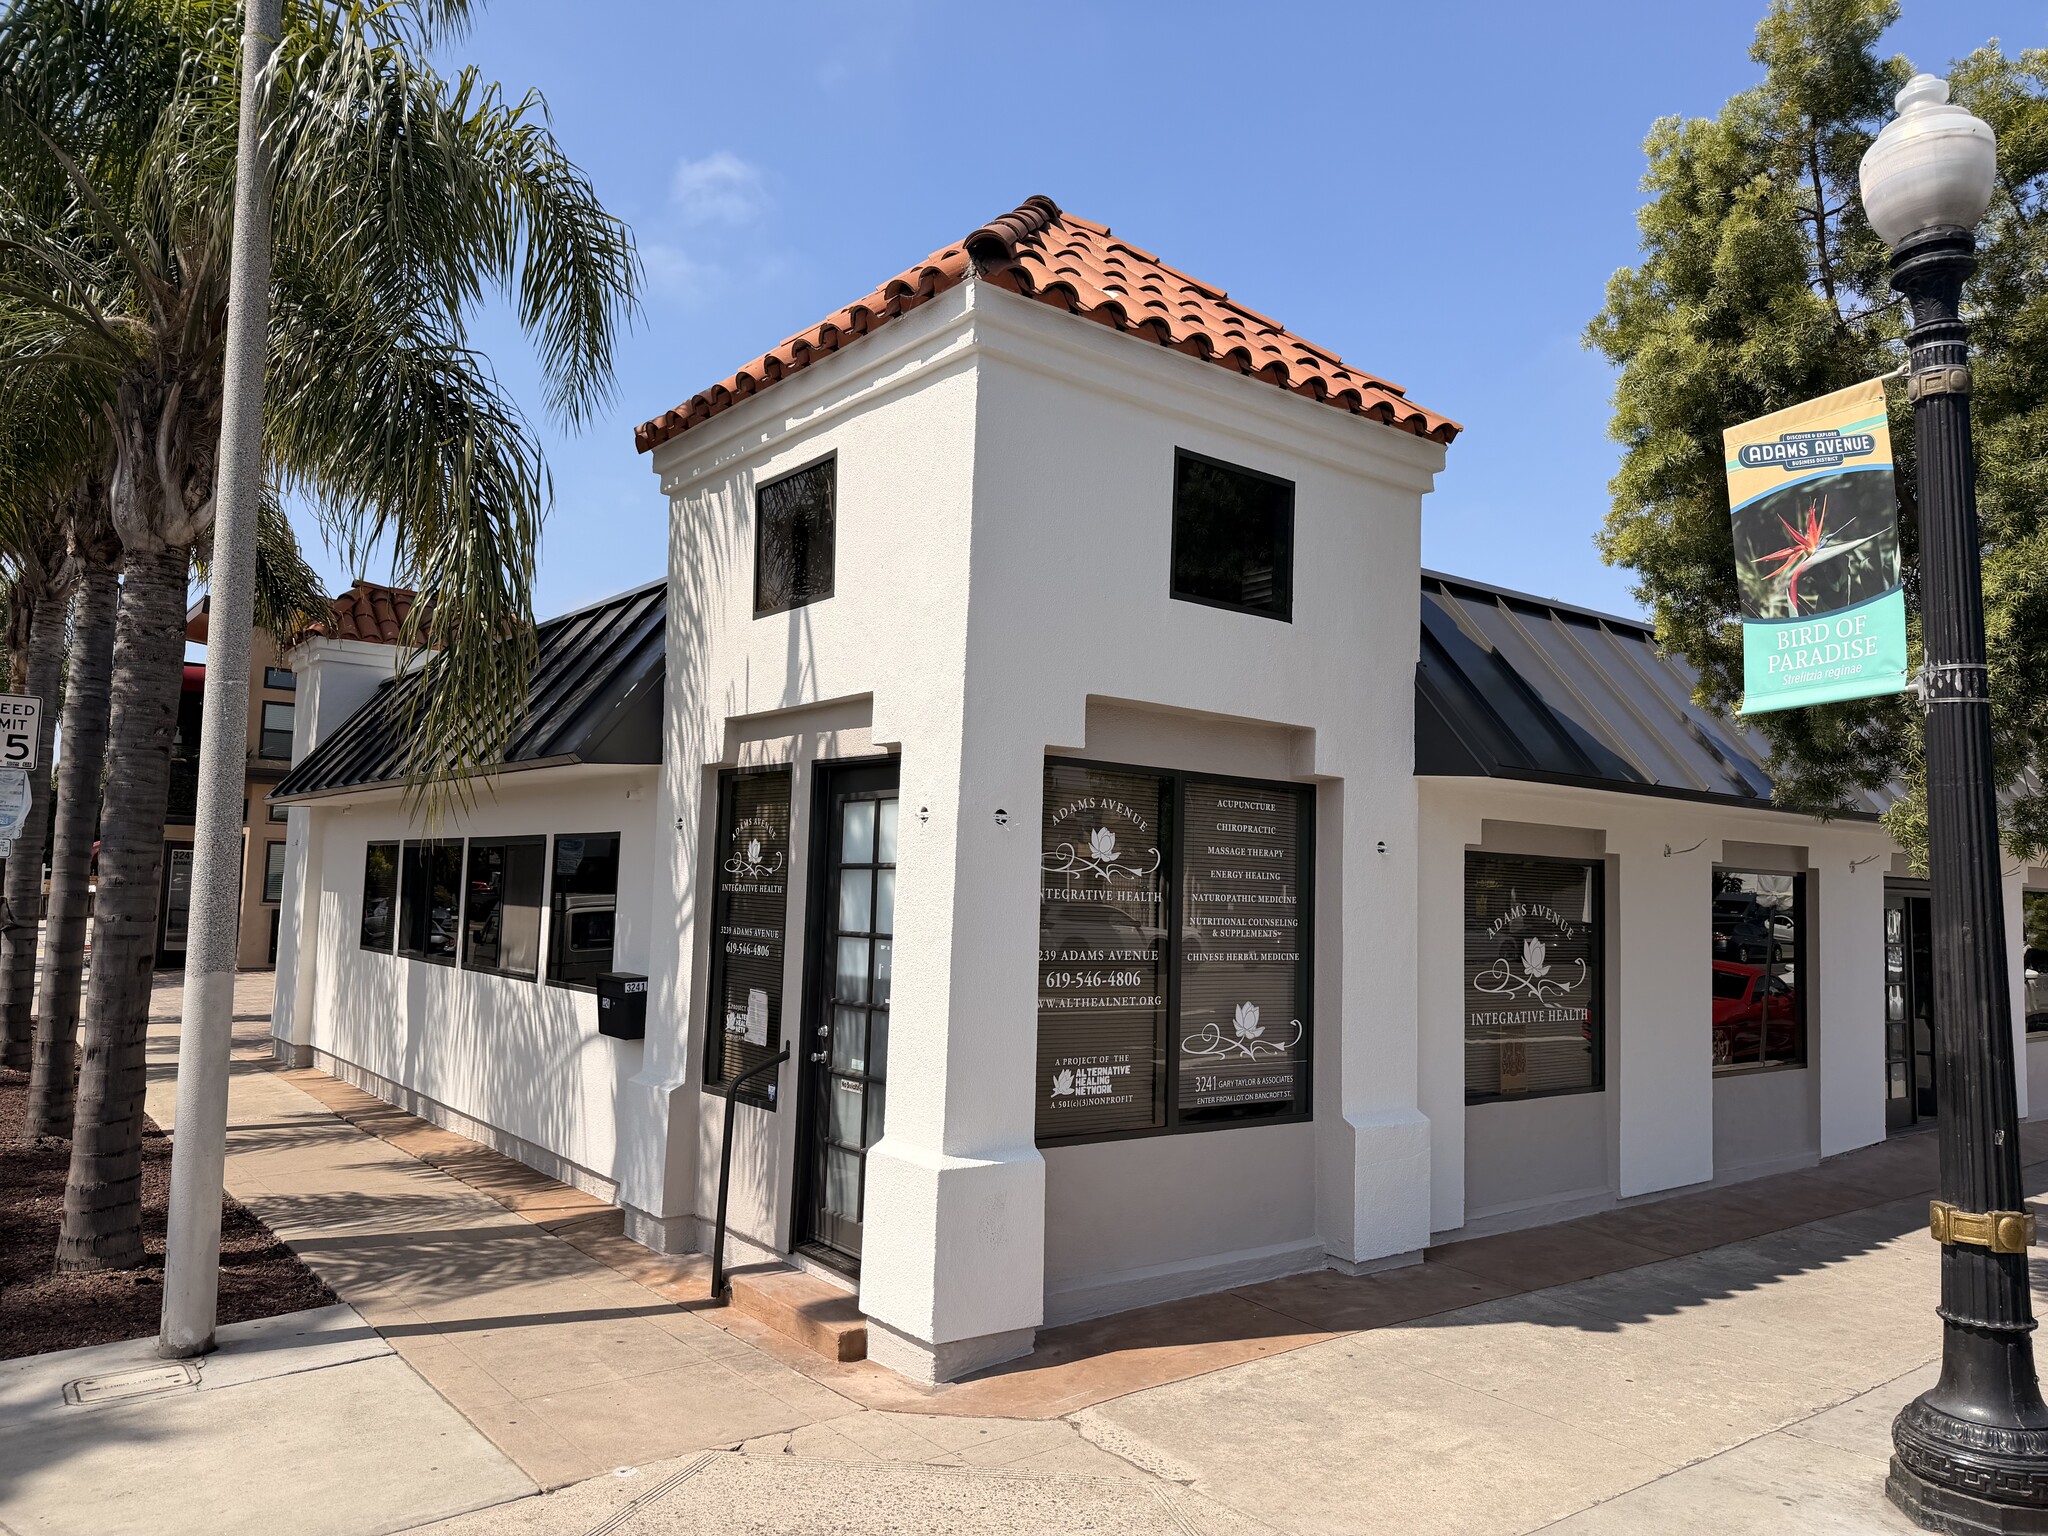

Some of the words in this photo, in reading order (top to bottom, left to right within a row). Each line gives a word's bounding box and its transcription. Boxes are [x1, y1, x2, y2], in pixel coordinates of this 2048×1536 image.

[1786, 432, 1811, 440] DISCOVER
[1749, 442, 1808, 462] ADAMS
[1815, 436, 1870, 455] AVENUE
[1792, 458, 1815, 466] BUSINESS
[1777, 623, 1830, 650] BIRD
[1836, 615, 1867, 638] OF
[1768, 636, 1878, 674] PARADISE
[1783, 670, 1822, 685] Strelitzia
[1825, 664, 1862, 679] reginae
[0, 703, 35, 716] EED
[0, 718, 27, 730] MIT
[0, 734, 29, 760] 5
[1217, 800, 1276, 811] ACUPUNCTURE
[1052, 797, 1096, 826] ADAMS
[1100, 798, 1148, 832] AVENUE
[732, 817, 752, 841] ADAMS
[753, 817, 777, 840] AVENUE
[1217, 823, 1276, 834] CHIROPRACTIC
[1207, 846, 1246, 855] MASSAGE
[1247, 848, 1284, 857] THERAPY
[1210, 870, 1243, 879] ENERGY
[1245, 871, 1281, 880] HEALING
[721, 883, 759, 892] INTEGRATIVE
[760, 885, 783, 893] HEALTH
[1040, 888, 1113, 901] NTEGRATIVE
[1117, 891, 1162, 902] HEALTH
[1192, 893, 1257, 903] NATUROPATHIC
[1258, 895, 1297, 904] MEDICINE
[1190, 917, 1247, 926] NUTRITIONAL
[1248, 918, 1298, 927] COUNSELING
[1487, 904, 1527, 940] ADAMS
[1531, 904, 1574, 940] AVENUE
[732, 927, 753, 936] ADAMS
[753, 929, 780, 938] AVENUE
[1212, 929, 1218, 937] &
[1220, 929, 1278, 937] SUPPLEMENTS
[726, 941, 769, 957] 619-546-4806
[1038, 950, 1057, 961] 239
[1061, 950, 1104, 961] ADAMS
[1108, 950, 1159, 961] AVENUE
[1187, 953, 1224, 961] CHINESE
[1226, 953, 1258, 961] HERBAL
[1260, 952, 1299, 961] MEDICINE
[1046, 970, 1141, 989] 619-546-4806
[626, 983, 645, 992] 3241
[1038, 995, 1162, 1009] WW.ALTHEALNET.ORG
[1471, 1011, 1545, 1026] INTEGRATIVE
[1548, 1008, 1588, 1021] HEALTH
[1063, 1056, 1097, 1066] PROJECT
[1099, 1055, 1110, 1063] OF
[1114, 1054, 1130, 1062] THE
[1075, 1065, 1131, 1078] ALTERNATIVE
[1075, 1076, 1110, 1087] HEALING
[1195, 1076, 1217, 1092] 3241
[1218, 1080, 1235, 1088] GARY
[1235, 1078, 1256, 1087] TAYLOR
[1256, 1077, 1261, 1085] &
[1261, 1075, 1294, 1084] ASSOCIATES
[1075, 1084, 1112, 1096] NETWORK
[1197, 1096, 1216, 1105] ENTER
[1216, 1095, 1233, 1103] FROM
[1233, 1094, 1244, 1102] LOT
[1254, 1091, 1284, 1100] BANCROFT
[1050, 1101, 1056, 1109] A
